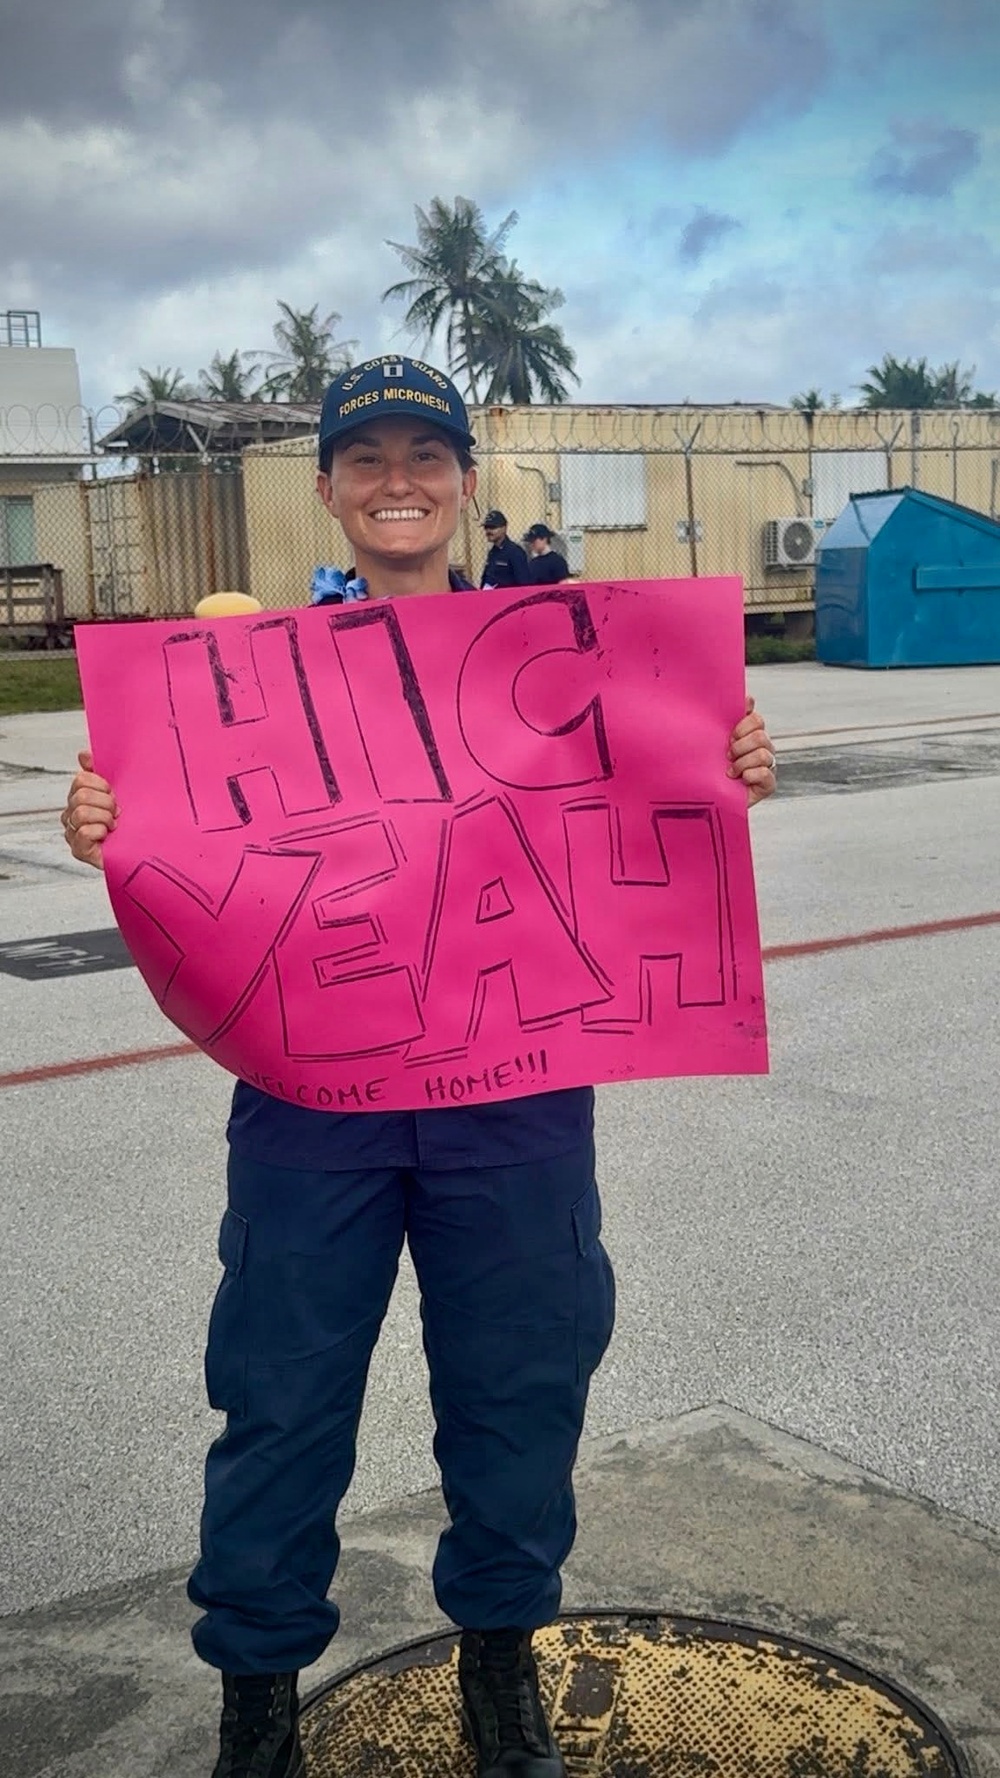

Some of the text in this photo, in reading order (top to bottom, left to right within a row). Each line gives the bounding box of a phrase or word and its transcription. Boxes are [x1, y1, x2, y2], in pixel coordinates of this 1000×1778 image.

[342, 355, 448, 391] U.S. COAST GUARD
[339, 388, 451, 418] FORCES MICRONESIA
[122, 791, 738, 1066] YEAH
[240, 1049, 549, 1106] WELCOME HOME!!!
